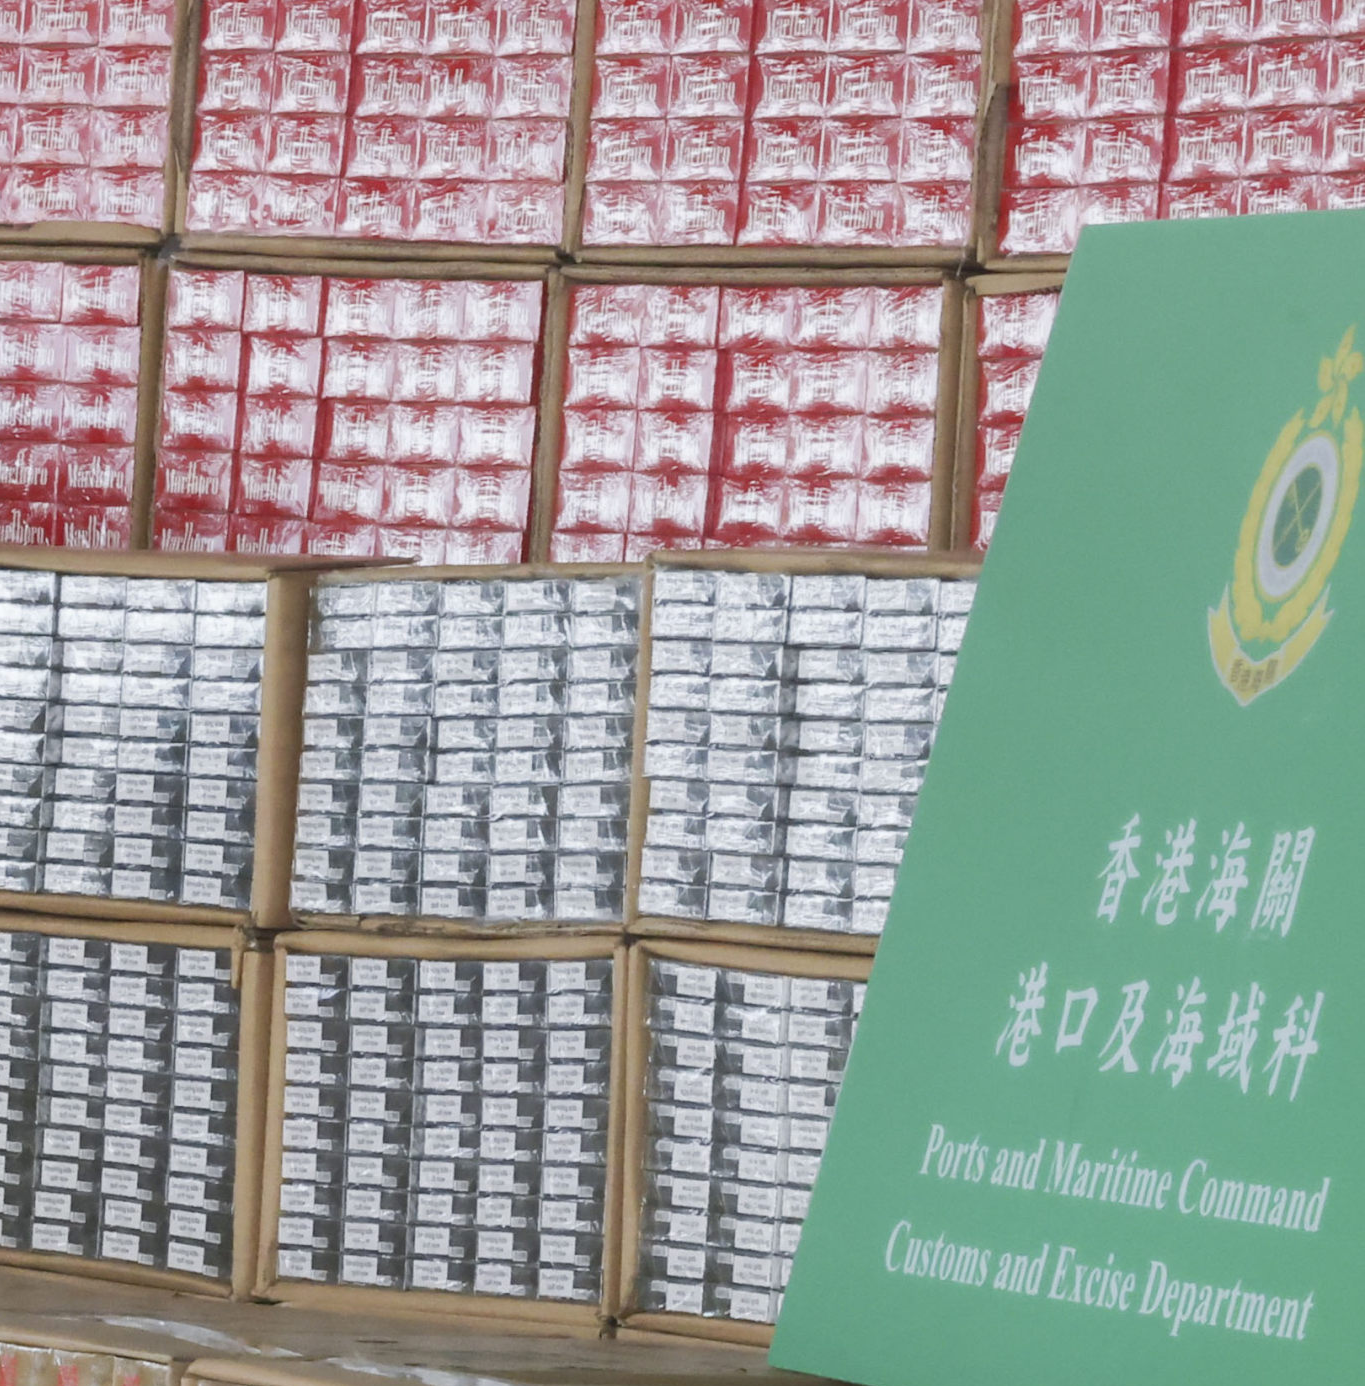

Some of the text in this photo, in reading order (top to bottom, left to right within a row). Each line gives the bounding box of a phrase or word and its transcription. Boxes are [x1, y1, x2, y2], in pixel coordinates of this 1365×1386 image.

[68, 459, 124, 489] Marlboro
[165, 461, 218, 494] Marlboro
[245, 470, 298, 501] Marlboro
[1094, 812, 1315, 939] 香港海關
[995, 962, 1326, 1102] 港口及海域科
[919, 1123, 1331, 1232] Ports and Maritime Command
[884, 1220, 1314, 1340] Customs and Excise Department
